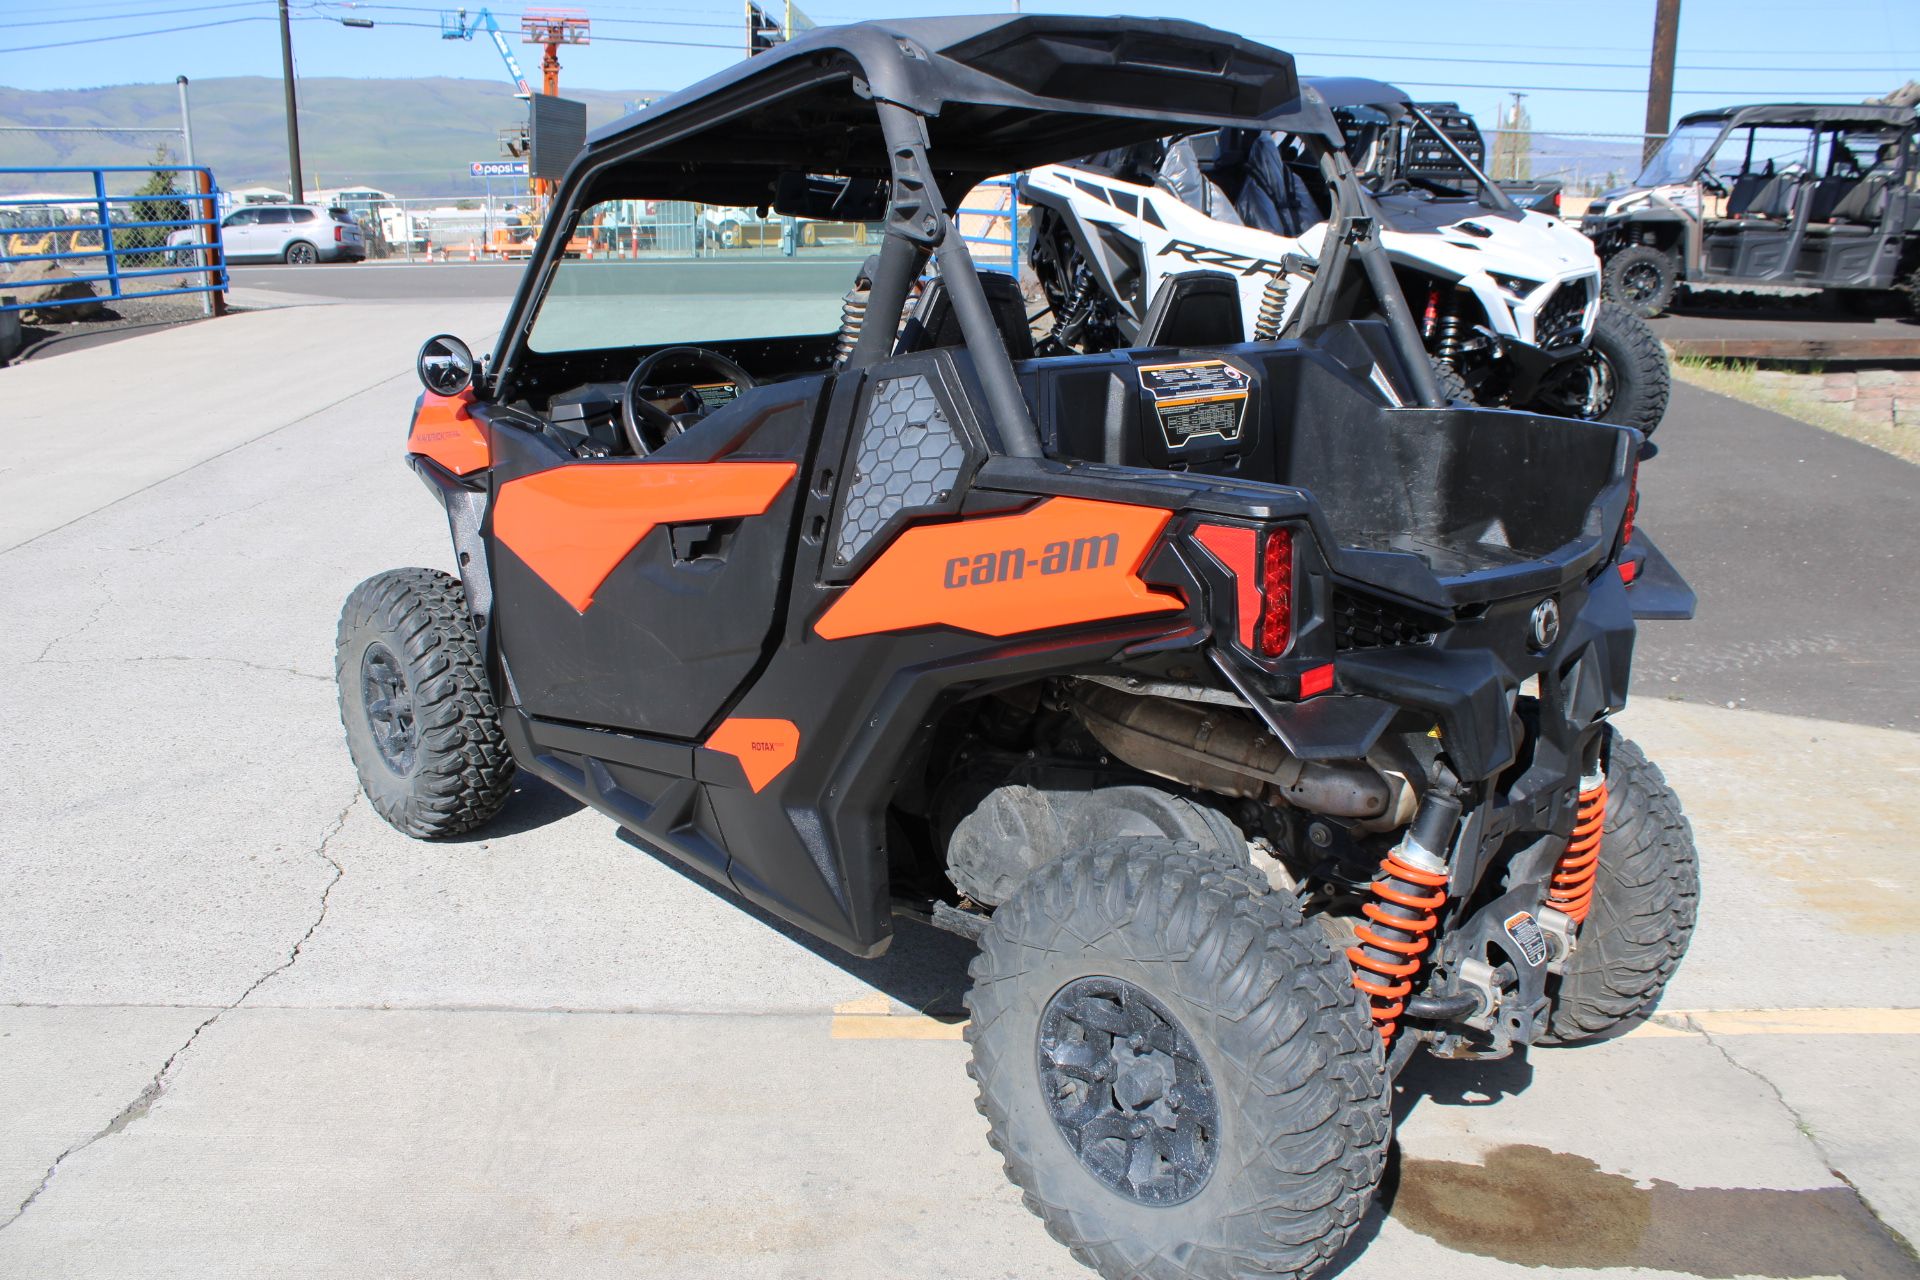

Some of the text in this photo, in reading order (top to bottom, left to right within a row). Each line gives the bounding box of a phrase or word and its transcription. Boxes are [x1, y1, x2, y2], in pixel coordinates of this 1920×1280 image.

[484, 162, 513, 174] pepsi
[944, 532, 1120, 589] can-am
[751, 742, 775, 751] ROTAX
